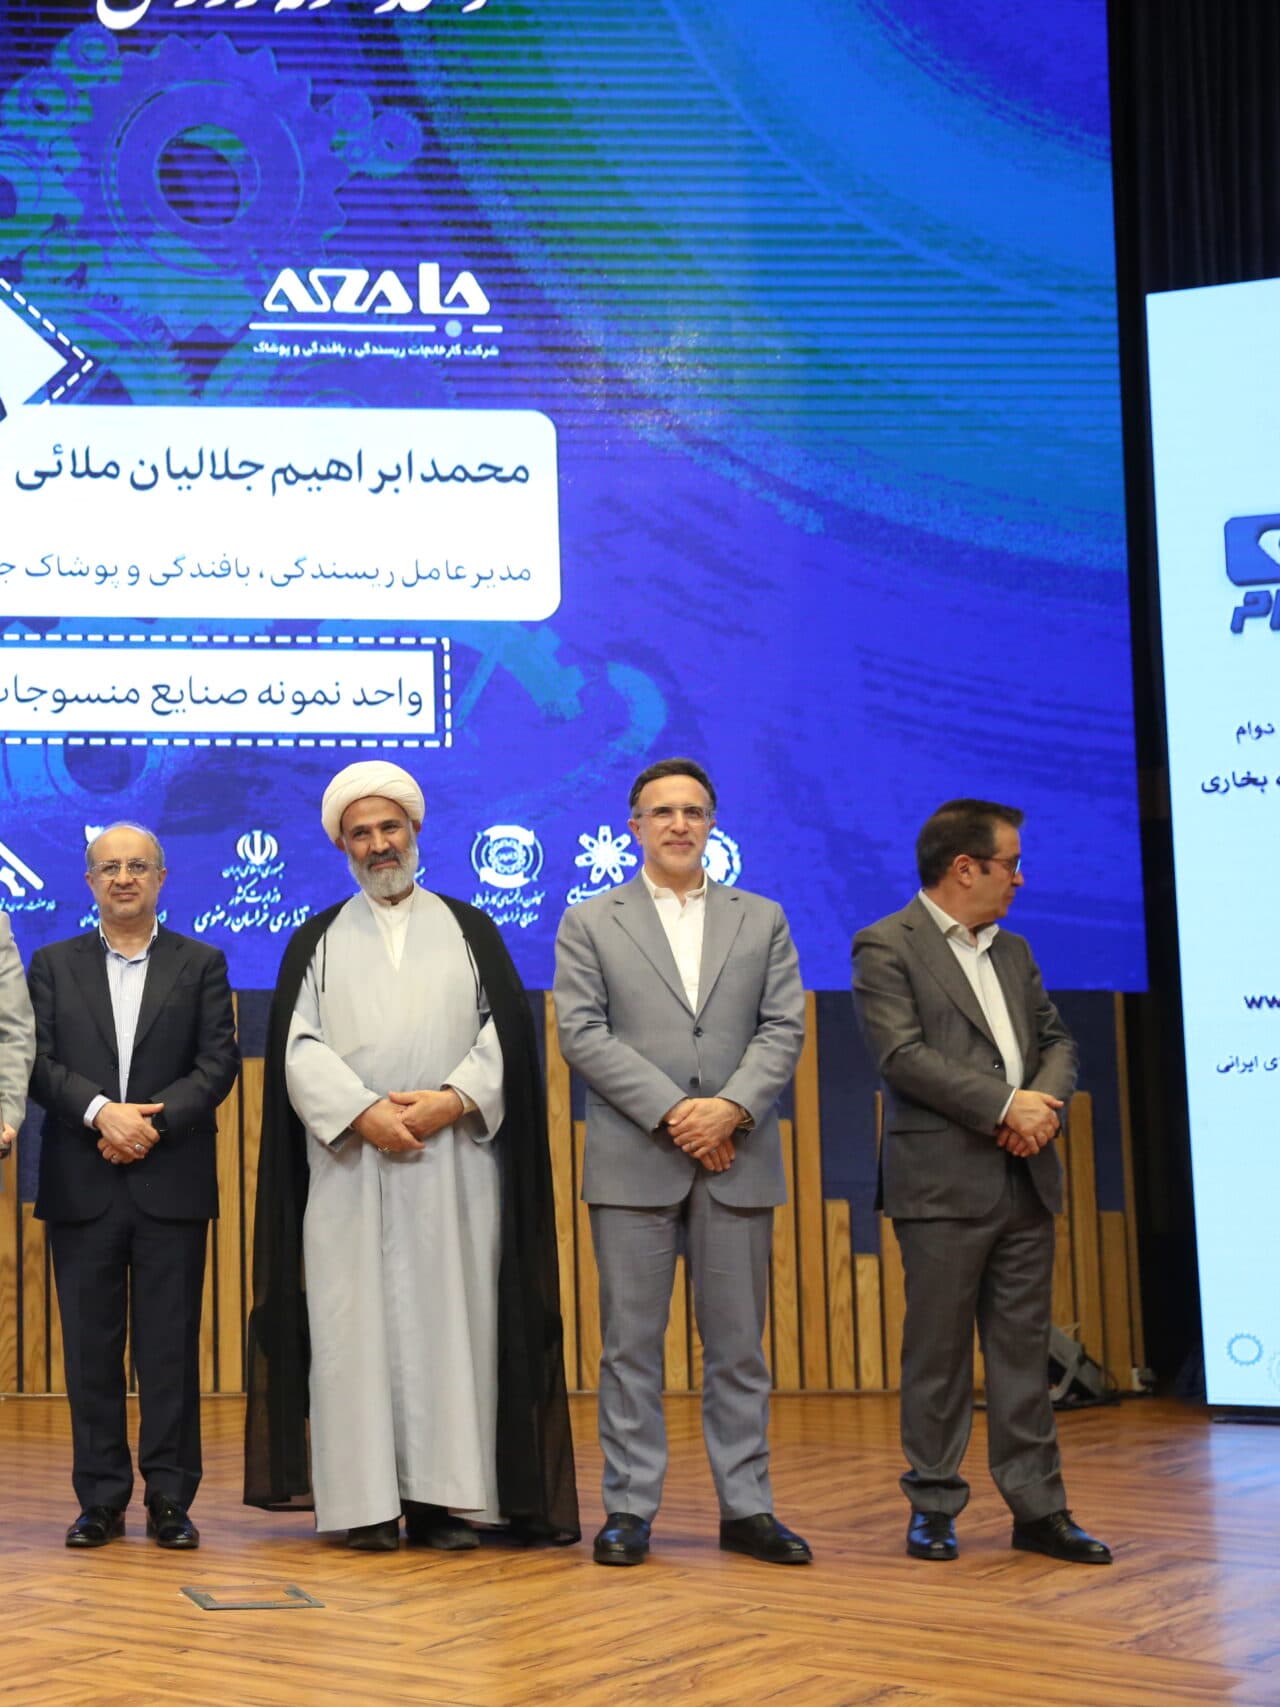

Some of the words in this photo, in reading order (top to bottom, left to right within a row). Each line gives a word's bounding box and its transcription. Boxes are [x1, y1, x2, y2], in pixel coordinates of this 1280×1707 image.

[15, 442, 121, 493] ملائی
[129, 445, 266, 493] جلالیان
[24, 553, 119, 589] پوشاک
[127, 563, 141, 587] و
[149, 552, 251, 588] بافندگی
[149, 675, 248, 718] صنایع
[257, 680, 341, 717] نمونه
[352, 677, 423, 718] واحد
[1201, 770, 1268, 795] بخاری
[1216, 1055, 1258, 1074] ایرانی
